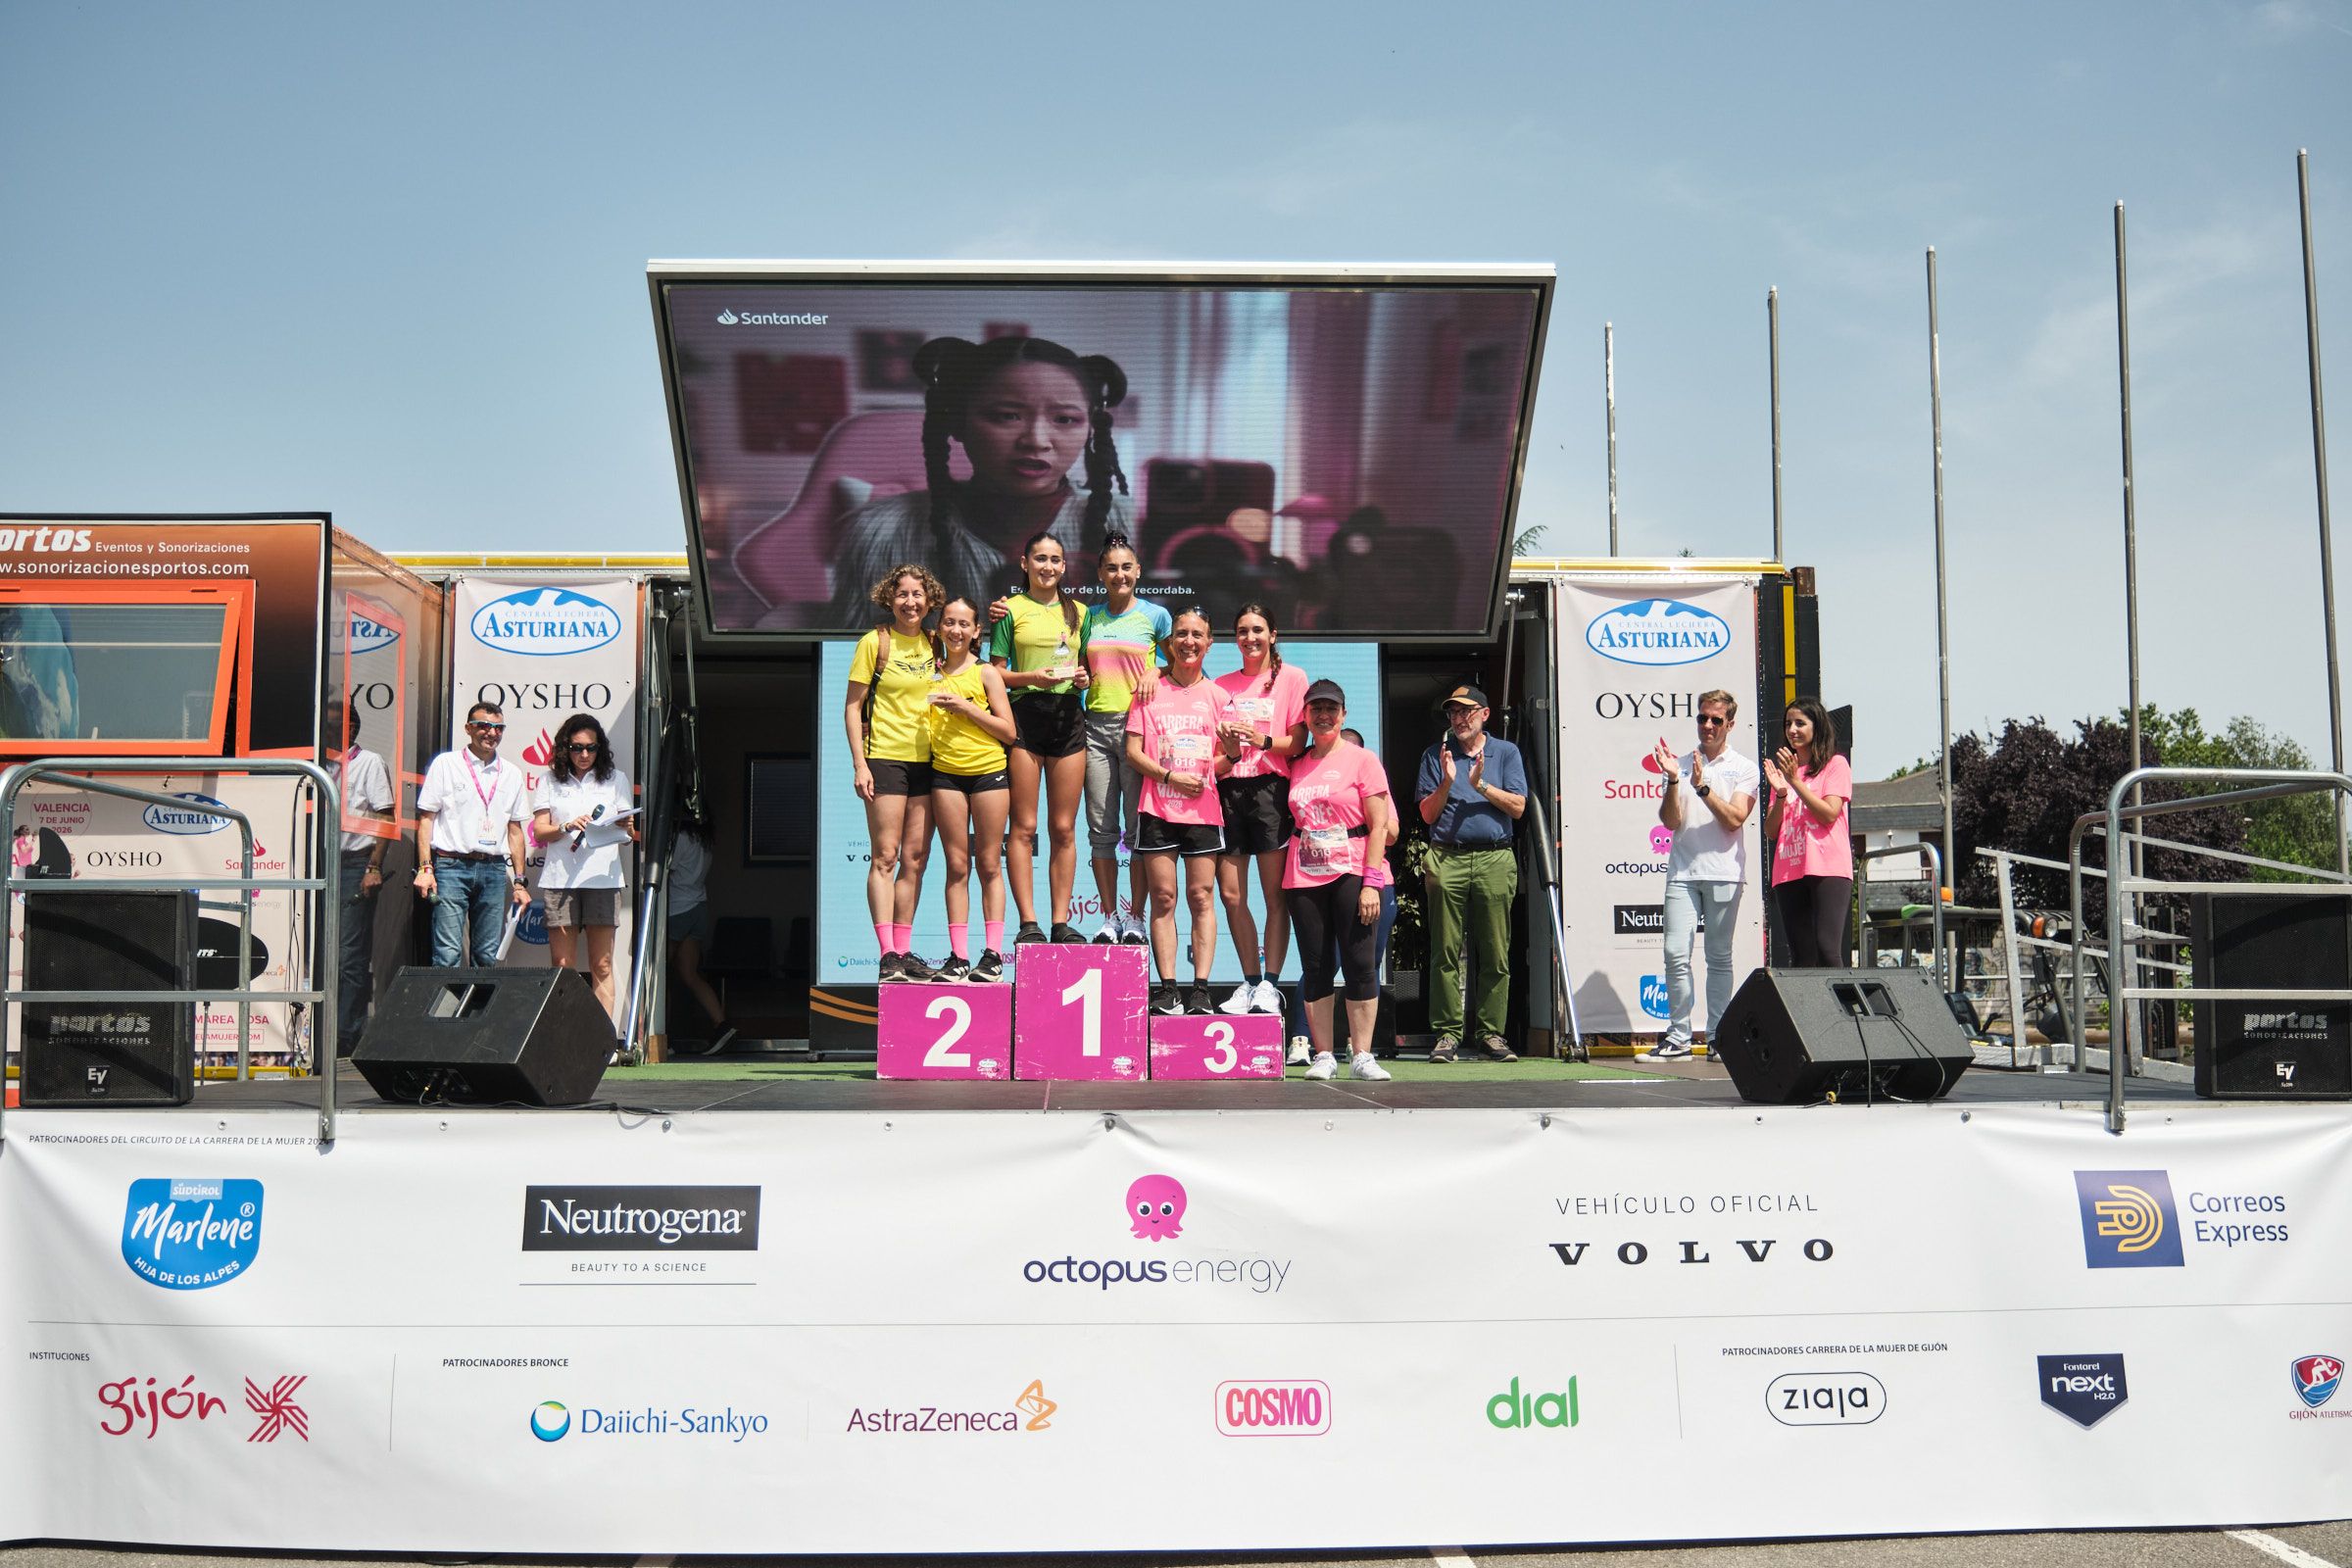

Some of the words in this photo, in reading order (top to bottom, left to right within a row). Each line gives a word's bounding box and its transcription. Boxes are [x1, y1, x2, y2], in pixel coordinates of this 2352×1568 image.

[740, 312, 829, 325] Santander
[95, 542, 143, 553] Eventos
[147, 544, 154, 554] y
[159, 541, 251, 553] Sonorizaciones
[1079, 586, 1093, 595] de
[1096, 586, 1107, 595] lo
[1135, 585, 1196, 595] recordaba.
[481, 612, 610, 638] ASTURIANA
[1597, 622, 1722, 649] ASTURIANA
[477, 683, 612, 710] OYSHO
[1595, 692, 1693, 719] OYSH
[1604, 780, 1664, 800] Santa
[33, 803, 90, 812] VALENCIA
[87, 851, 162, 867] OYSHO
[225, 859, 285, 870] Sanander
[1605, 861, 1668, 877] octopus
[249, 1014, 270, 1025] OSA
[1061, 968, 1102, 1057] 1
[922, 996, 972, 1068] 2
[1202, 1021, 1238, 1074] 3
[28, 1135, 109, 1144] PATROCINADORES
[130, 1136, 172, 1145] CIRCUITO
[1556, 1193, 1695, 1216] VEHÍCULO
[1710, 1194, 1818, 1213] OFICIAL
[2188, 1191, 2286, 1214] Correos
[539, 1199, 743, 1245] Neutrogena
[2194, 1219, 2289, 1248] Express
[1548, 1238, 1834, 1266] VOLVO
[133, 1256, 157, 1278] HIJA
[159, 1271, 175, 1284] DE
[177, 1274, 201, 1285] LOS
[203, 1259, 240, 1284] ALPES
[571, 1262, 617, 1272] BEAUTY
[622, 1262, 638, 1272] TO
[642, 1262, 650, 1272] A
[654, 1262, 707, 1272] SCIENCE
[1023, 1255, 1168, 1291] octopus
[1172, 1259, 1292, 1293] energy
[28, 1351, 90, 1362] INSTITUCIONES
[1722, 1346, 1804, 1356] PATROCINADORES
[1806, 1346, 1847, 1355] CARRERA
[1849, 1345, 1861, 1353] DE
[1863, 1345, 1875, 1353] LA
[1877, 1344, 1906, 1353] MUJER
[1908, 1344, 1919, 1352] DE
[1921, 1342, 1948, 1351] GIJÓN
[442, 1358, 527, 1367] PATROCINADORES
[530, 1358, 569, 1367] BRONCE
[2063, 1362, 2100, 1371] Fontarel
[2051, 1373, 2116, 1393] next
[98, 1374, 227, 1440] gijón
[1225, 1387, 1322, 1427] COSMO
[1486, 1374, 1580, 1429] dial
[1783, 1387, 1868, 1418] ziaja
[581, 1407, 768, 1443] Daiichi-Sankyo
[847, 1406, 1018, 1432] AstraZeneca
[2288, 1408, 2318, 1422] GIJÓN
